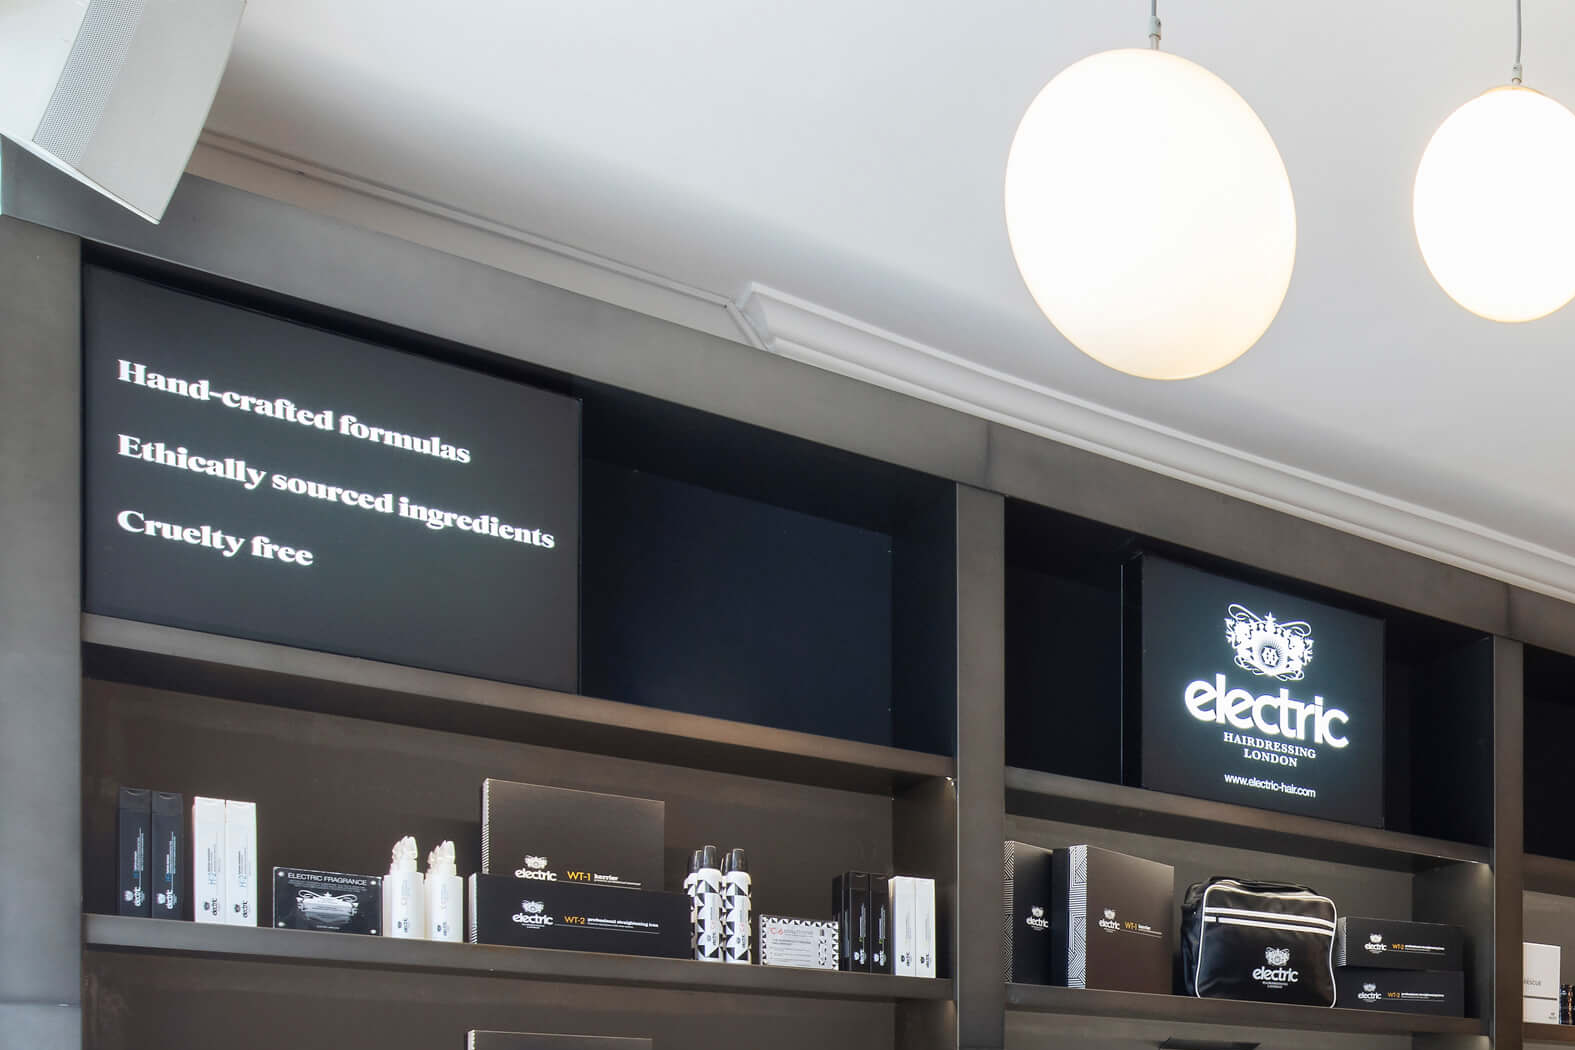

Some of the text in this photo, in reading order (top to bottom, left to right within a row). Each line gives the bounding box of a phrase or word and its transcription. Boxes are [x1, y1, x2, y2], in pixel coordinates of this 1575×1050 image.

[117, 359, 471, 464] Hand-crafted formulas
[117, 433, 555, 548] Ethically sourced ingredients
[116, 510, 314, 566] Cruelty free
[1184, 673, 1350, 748] electric
[1223, 731, 1317, 759] HAIRDRESSING
[1243, 748, 1298, 768] LONDON
[1224, 773, 1316, 798] www.electric-hair.com
[287, 872, 323, 882] ELECTRIC
[323, 876, 368, 886] FRAGRANCE
[514, 868, 558, 882] electric
[567, 871, 592, 881] WT-1
[512, 912, 554, 925] electric
[564, 915, 586, 925] WT-2
[1026, 916, 1049, 928] electric
[1099, 918, 1121, 930] electric
[1364, 942, 1388, 951] electric
[1252, 966, 1299, 983] electric
[1357, 991, 1382, 1000] electric
